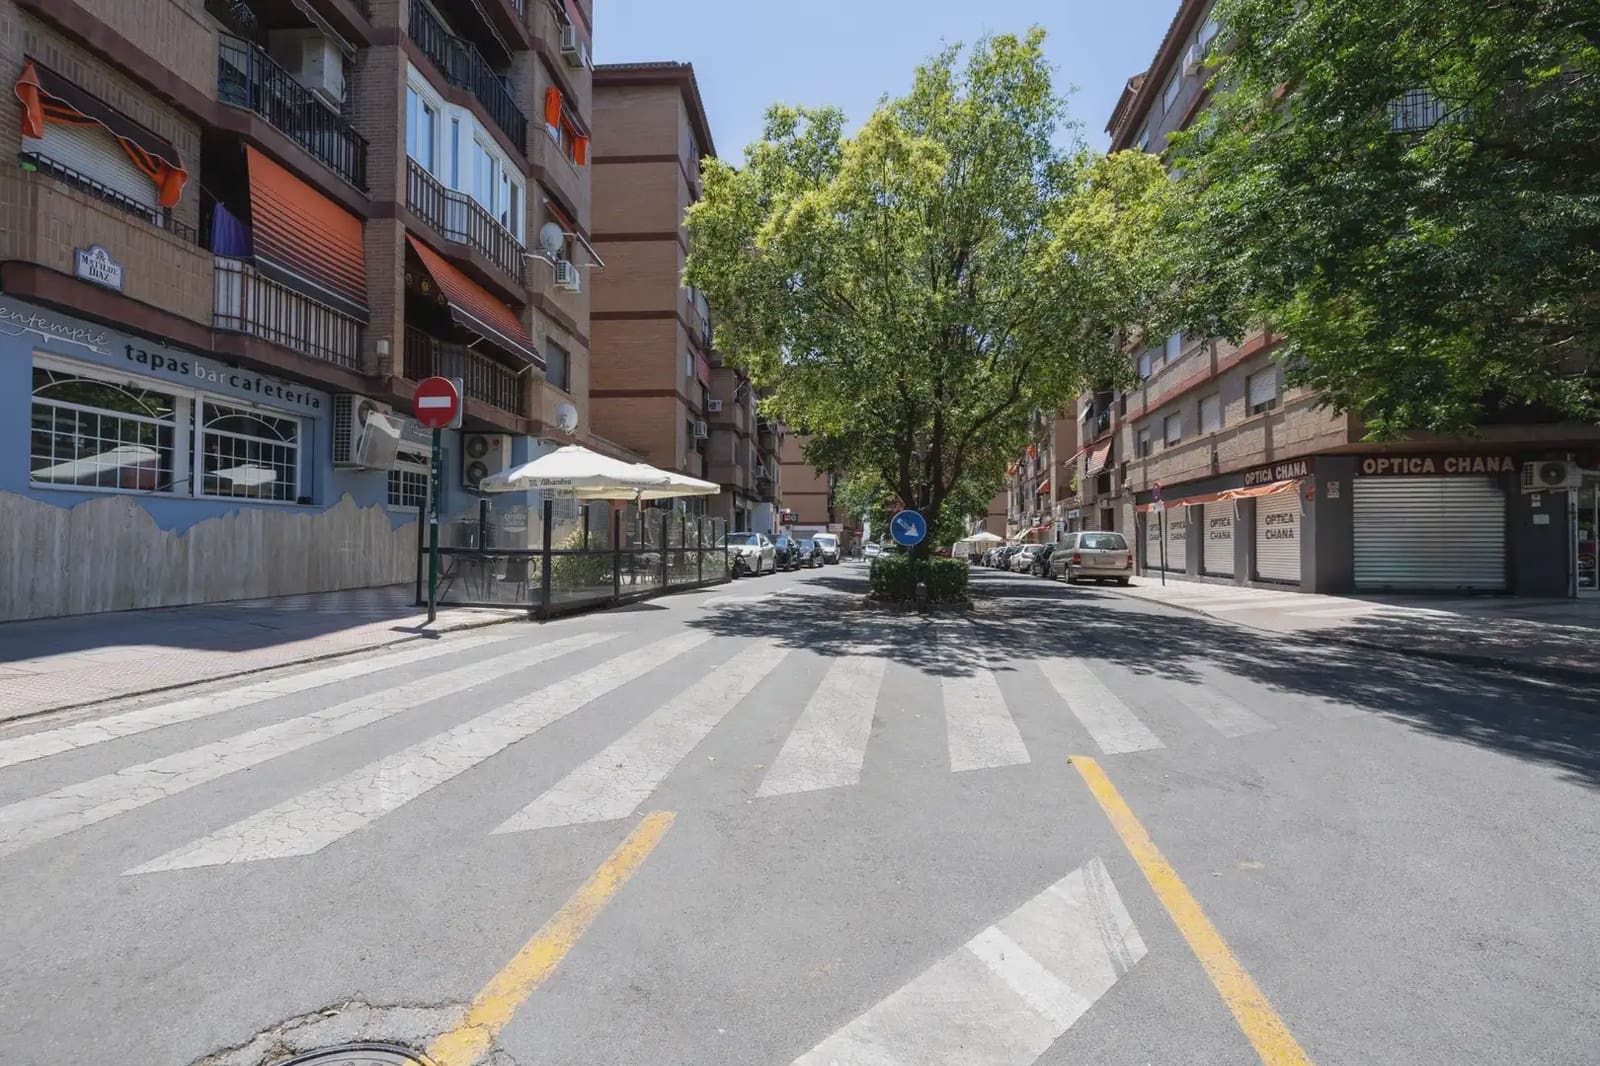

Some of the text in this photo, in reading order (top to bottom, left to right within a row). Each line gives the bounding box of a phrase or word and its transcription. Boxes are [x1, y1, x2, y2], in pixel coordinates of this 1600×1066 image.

[125, 344, 189, 374] tapas
[195, 361, 225, 384] bar
[1362, 455, 1515, 474] OPTICA CHANA
[1244, 461, 1307, 486] OPTICA CHANA
[1210, 517, 1232, 528] OPTICA
[1265, 513, 1294, 525] OPTICA
[1210, 530, 1232, 540] CHANA
[1265, 528, 1294, 540] CHANA
